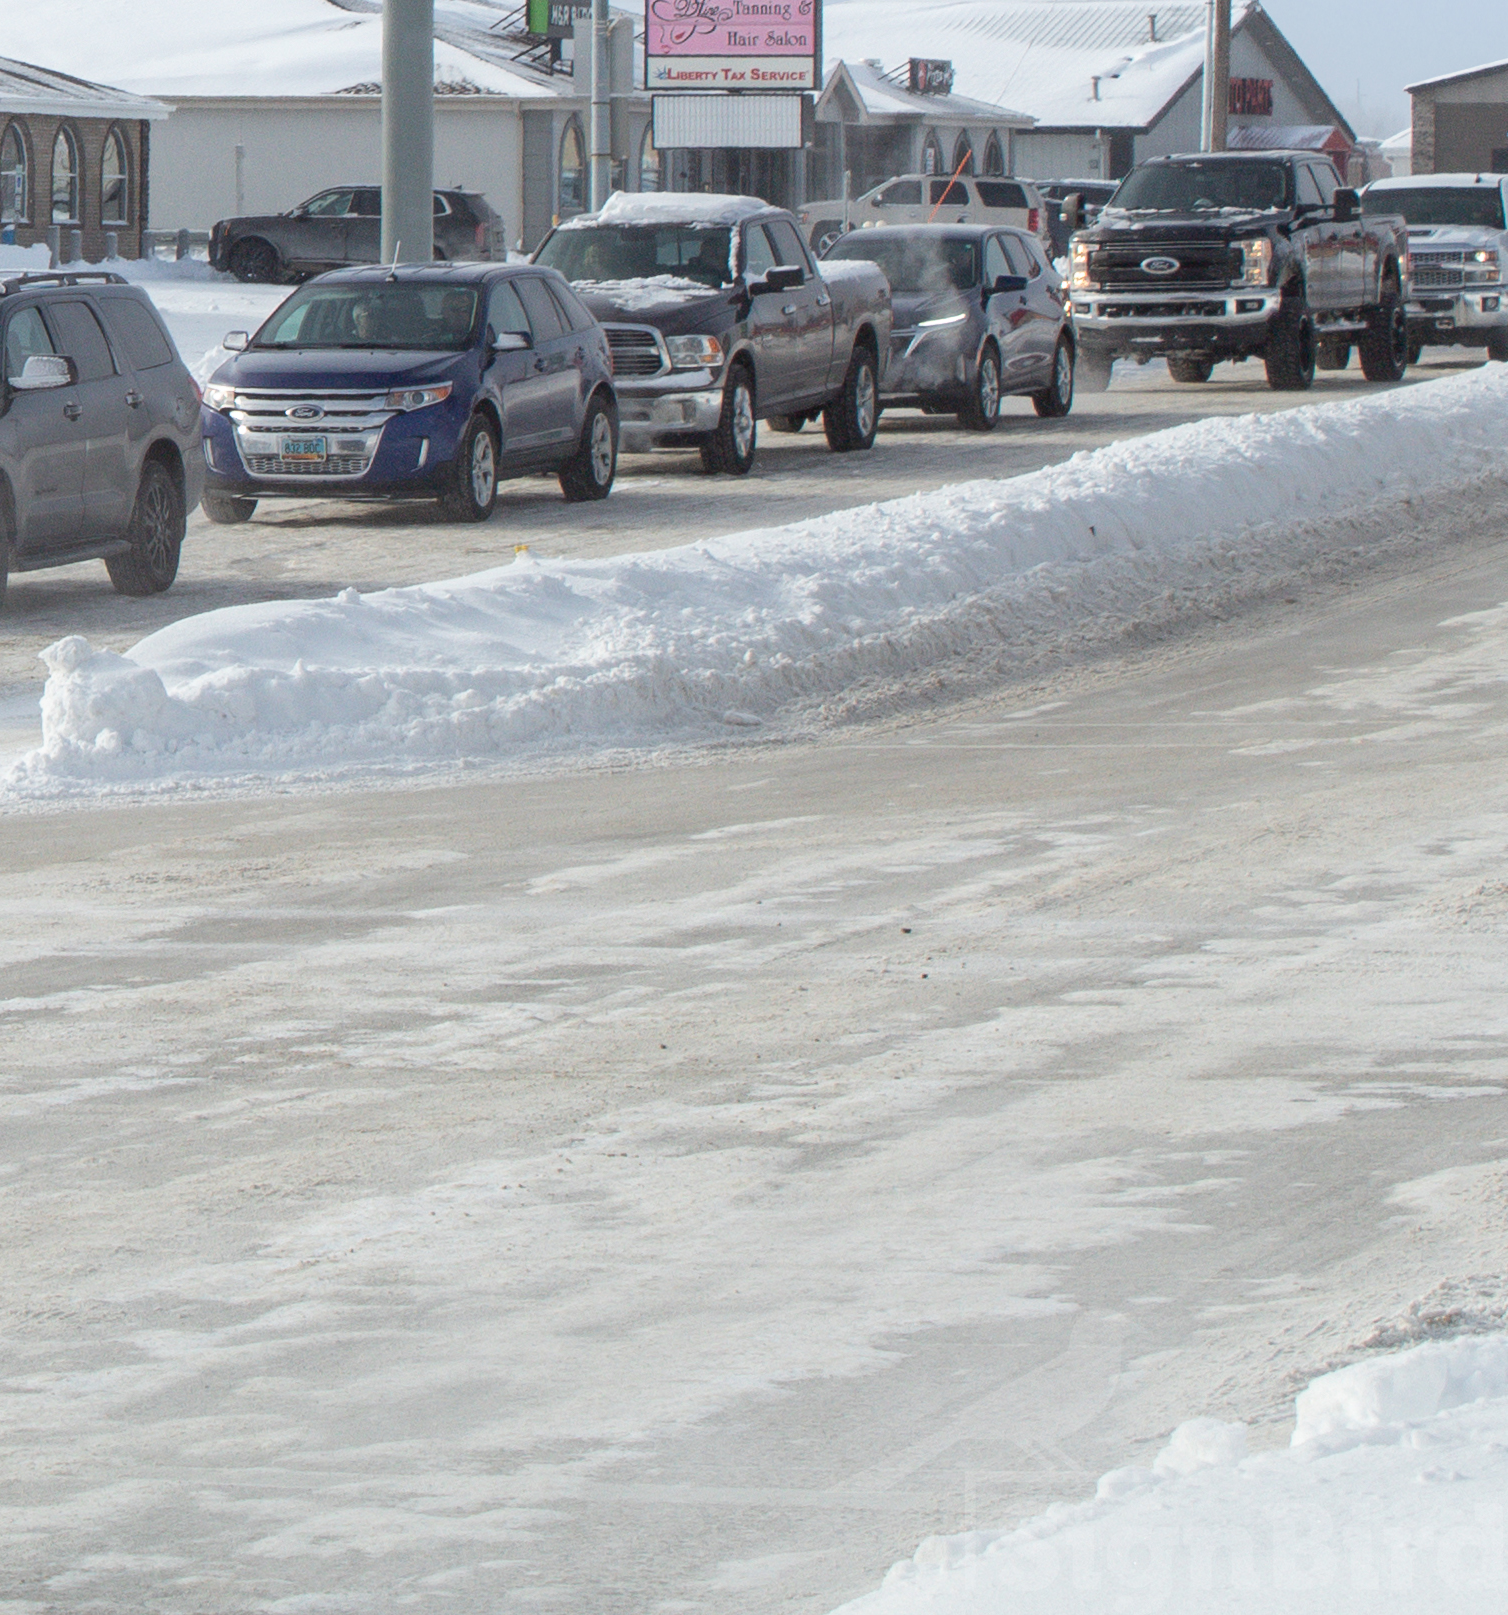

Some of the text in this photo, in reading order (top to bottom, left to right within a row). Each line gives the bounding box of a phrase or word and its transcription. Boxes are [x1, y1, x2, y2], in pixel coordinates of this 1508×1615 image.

[733, 0, 791, 21] Tanning
[798, 0, 812, 15] &
[727, 30, 807, 46] Hair Salon
[668, 68, 806, 80] LIBERTY TAX SERVICE
